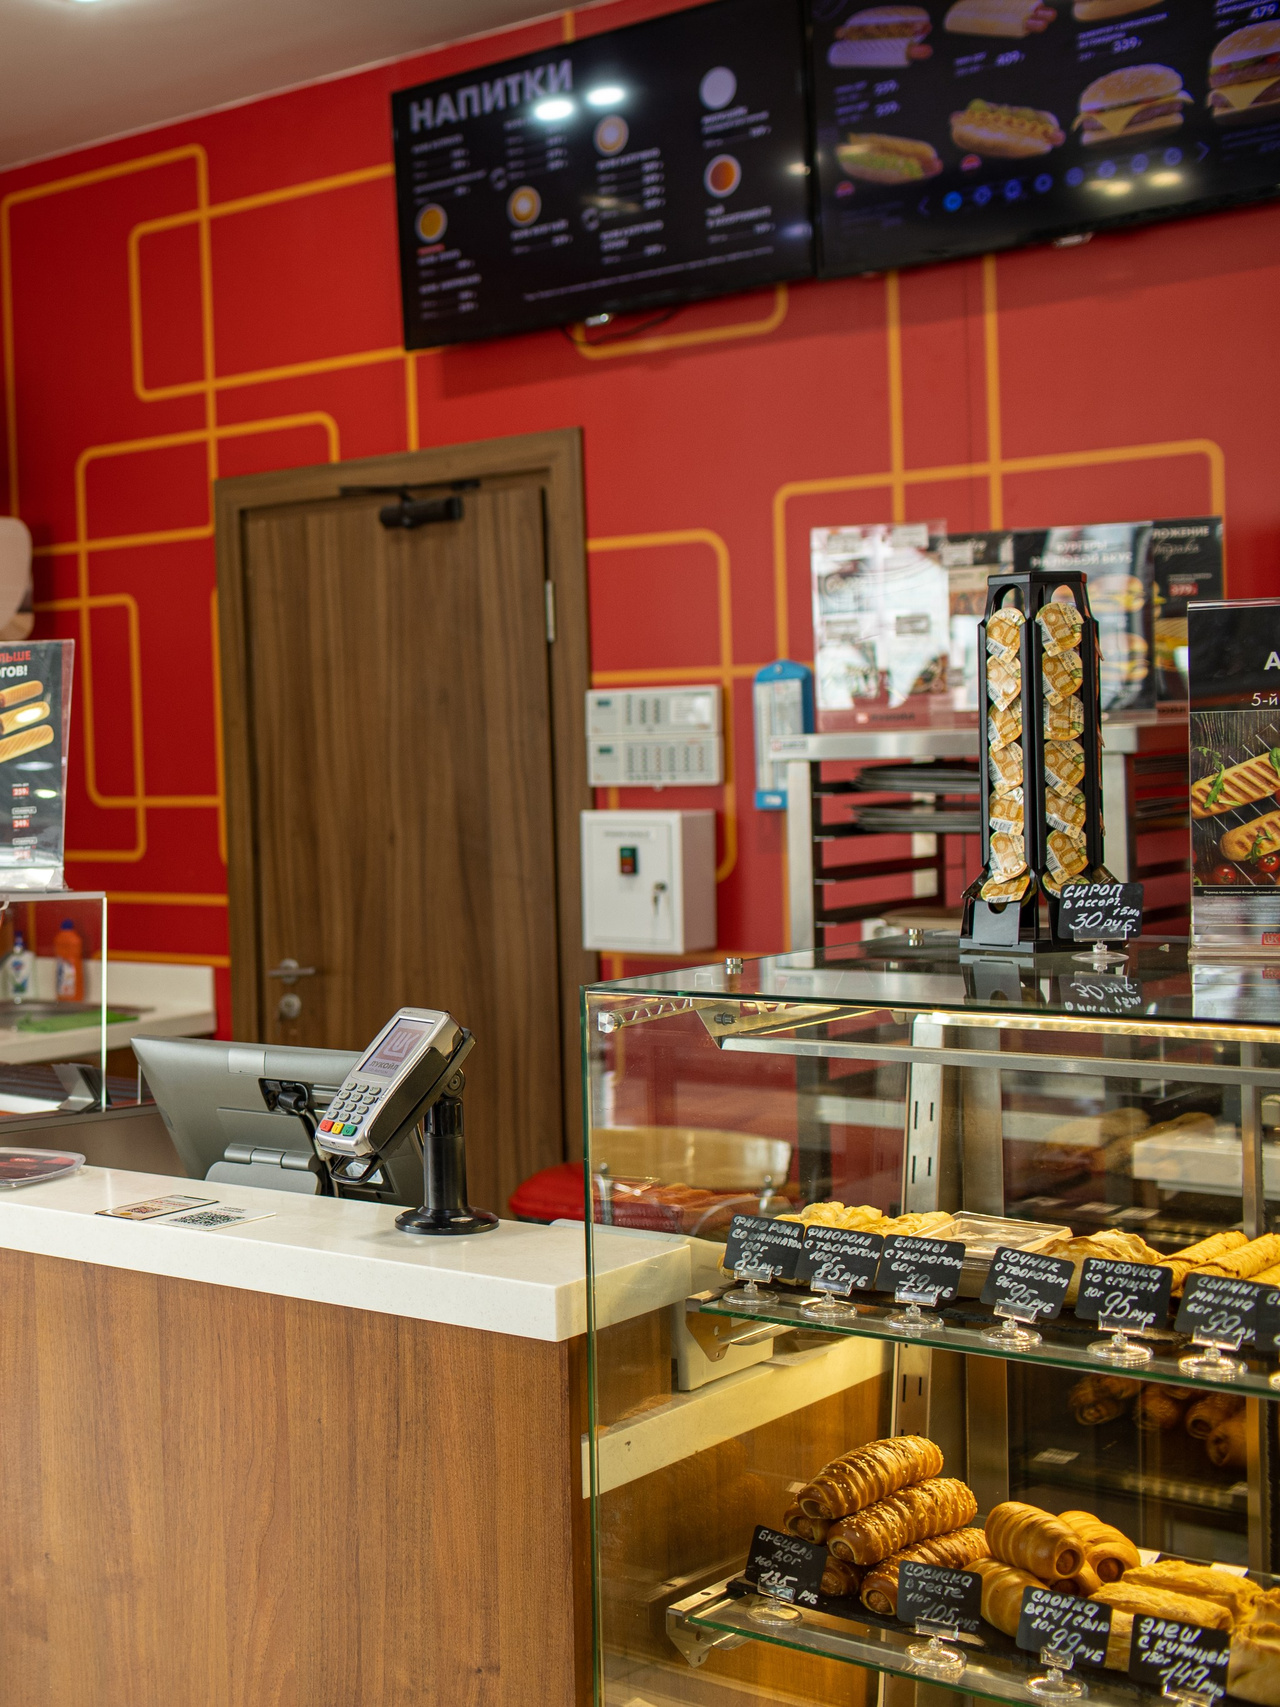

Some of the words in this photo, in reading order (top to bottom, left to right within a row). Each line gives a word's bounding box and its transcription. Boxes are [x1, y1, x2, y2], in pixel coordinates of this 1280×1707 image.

[409, 58, 574, 133] НАПИТКИ
[1251, 691, 1279, 707] 5-й
[1063, 884, 1124, 899] СИРОП
[1063, 900, 1073, 909] В
[1068, 911, 1103, 930] 30
[368, 1060, 400, 1071] ЛУКОЙЛ
[731, 1229, 748, 1240] СО
[894, 1236, 948, 1254] БЛИНЫ
[734, 1250, 763, 1271] 85
[804, 1240, 814, 1249] С
[815, 1241, 881, 1260] ТВОРОГОМ
[884, 1249, 894, 1258] С
[895, 1250, 963, 1270] ТВОРОГОМ
[814, 1262, 846, 1281] 85
[1000, 1250, 1062, 1273] СОЧНИК
[1090, 1259, 1163, 1280] ТРУБОЧКА
[898, 1272, 930, 1293] 79
[1004, 1264, 1070, 1288] ТВОРОГОМ
[1084, 1272, 1103, 1283] СО
[1197, 1276, 1261, 1297] СЫРНИК
[1004, 1283, 1038, 1306] 95
[1097, 1291, 1139, 1319] 95
[1188, 1289, 1256, 1312] МАЛИНА
[1200, 1310, 1242, 1334] 99
[760, 1570, 798, 1589] 135
[904, 1563, 973, 1588] СОСИСКА
[921, 1602, 960, 1626] 105
[1031, 1590, 1100, 1618] СЛОЙКА
[1139, 1617, 1202, 1643] ЭЛЕШ
[1047, 1628, 1082, 1655] 99
[1137, 1634, 1150, 1649] С
[1158, 1660, 1211, 1689] 149
